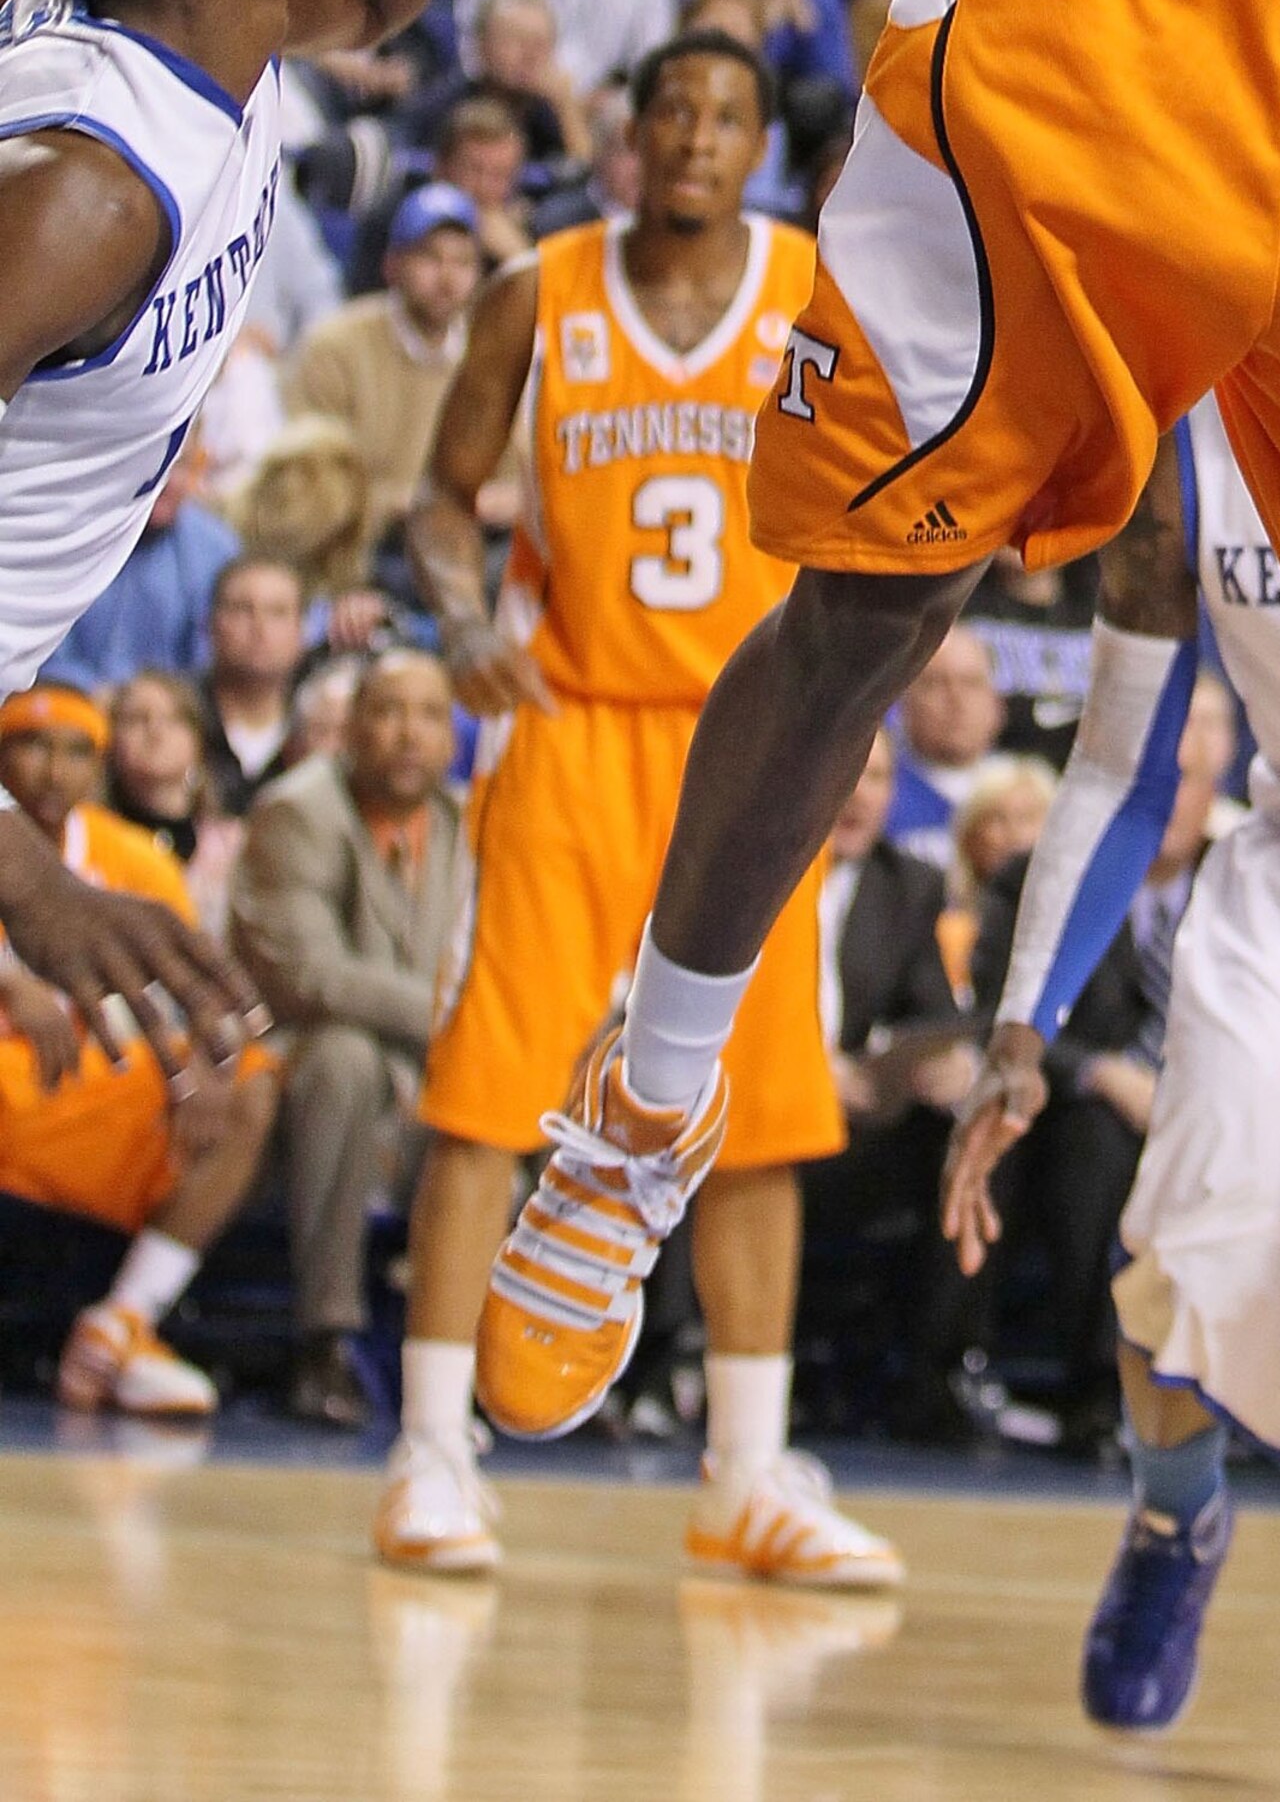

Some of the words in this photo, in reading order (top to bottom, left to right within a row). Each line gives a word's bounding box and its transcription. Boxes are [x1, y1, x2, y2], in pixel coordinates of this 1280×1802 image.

[777, 325, 840, 424] T
[558, 400, 755, 474] TENNESS
[630, 475, 725, 611] 3
[906, 528, 968, 545] adidas
